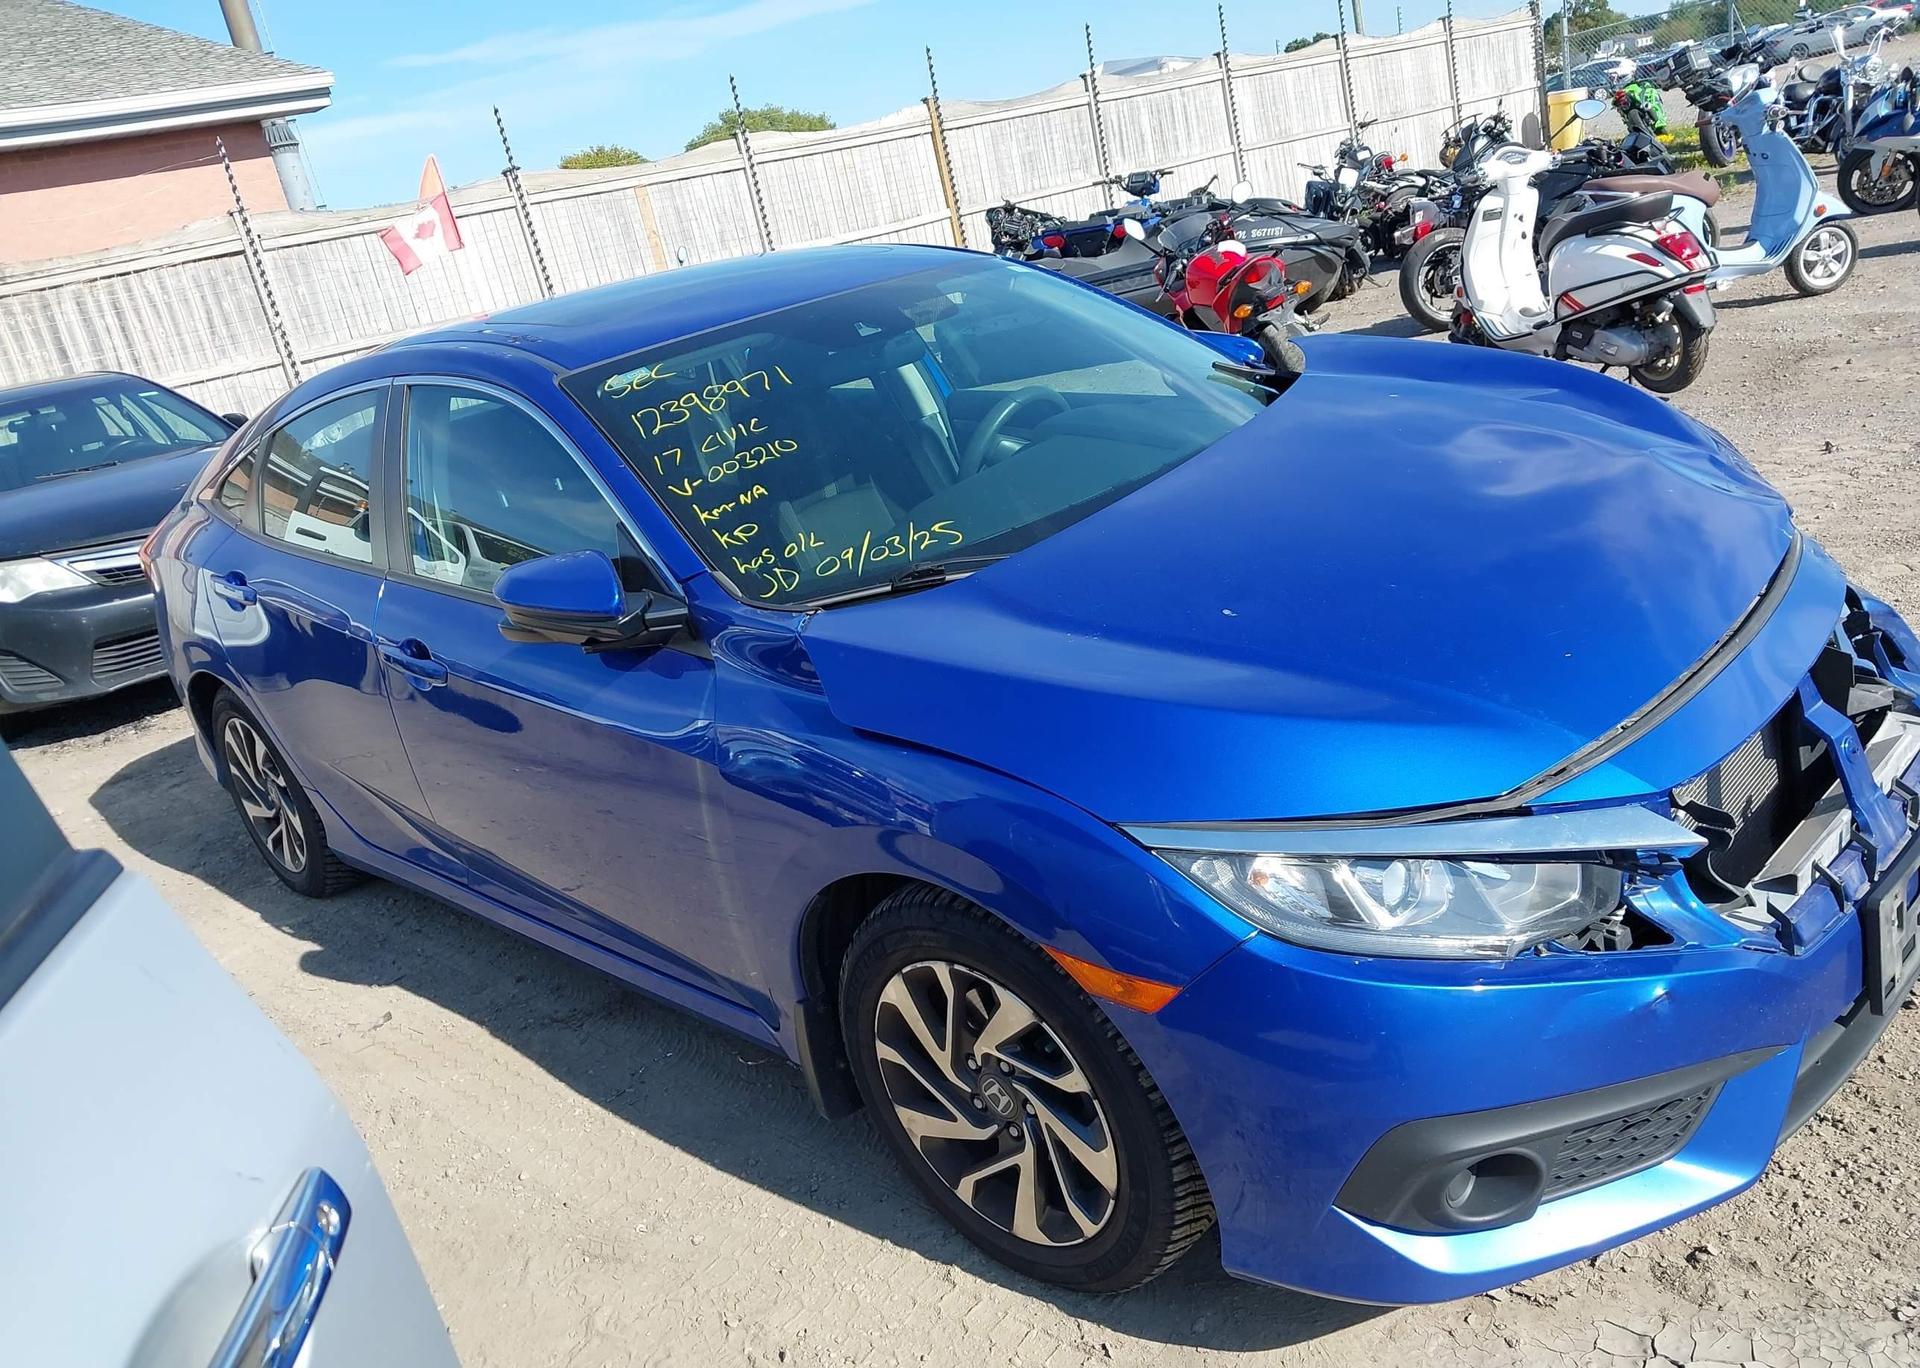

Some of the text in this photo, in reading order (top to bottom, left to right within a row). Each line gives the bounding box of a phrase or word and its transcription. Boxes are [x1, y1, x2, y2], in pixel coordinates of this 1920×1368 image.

[630, 365, 793, 440] 12398971
[653, 417, 769, 476] 17 CIVIC
[759, 520, 964, 598] JD 09/03/25
